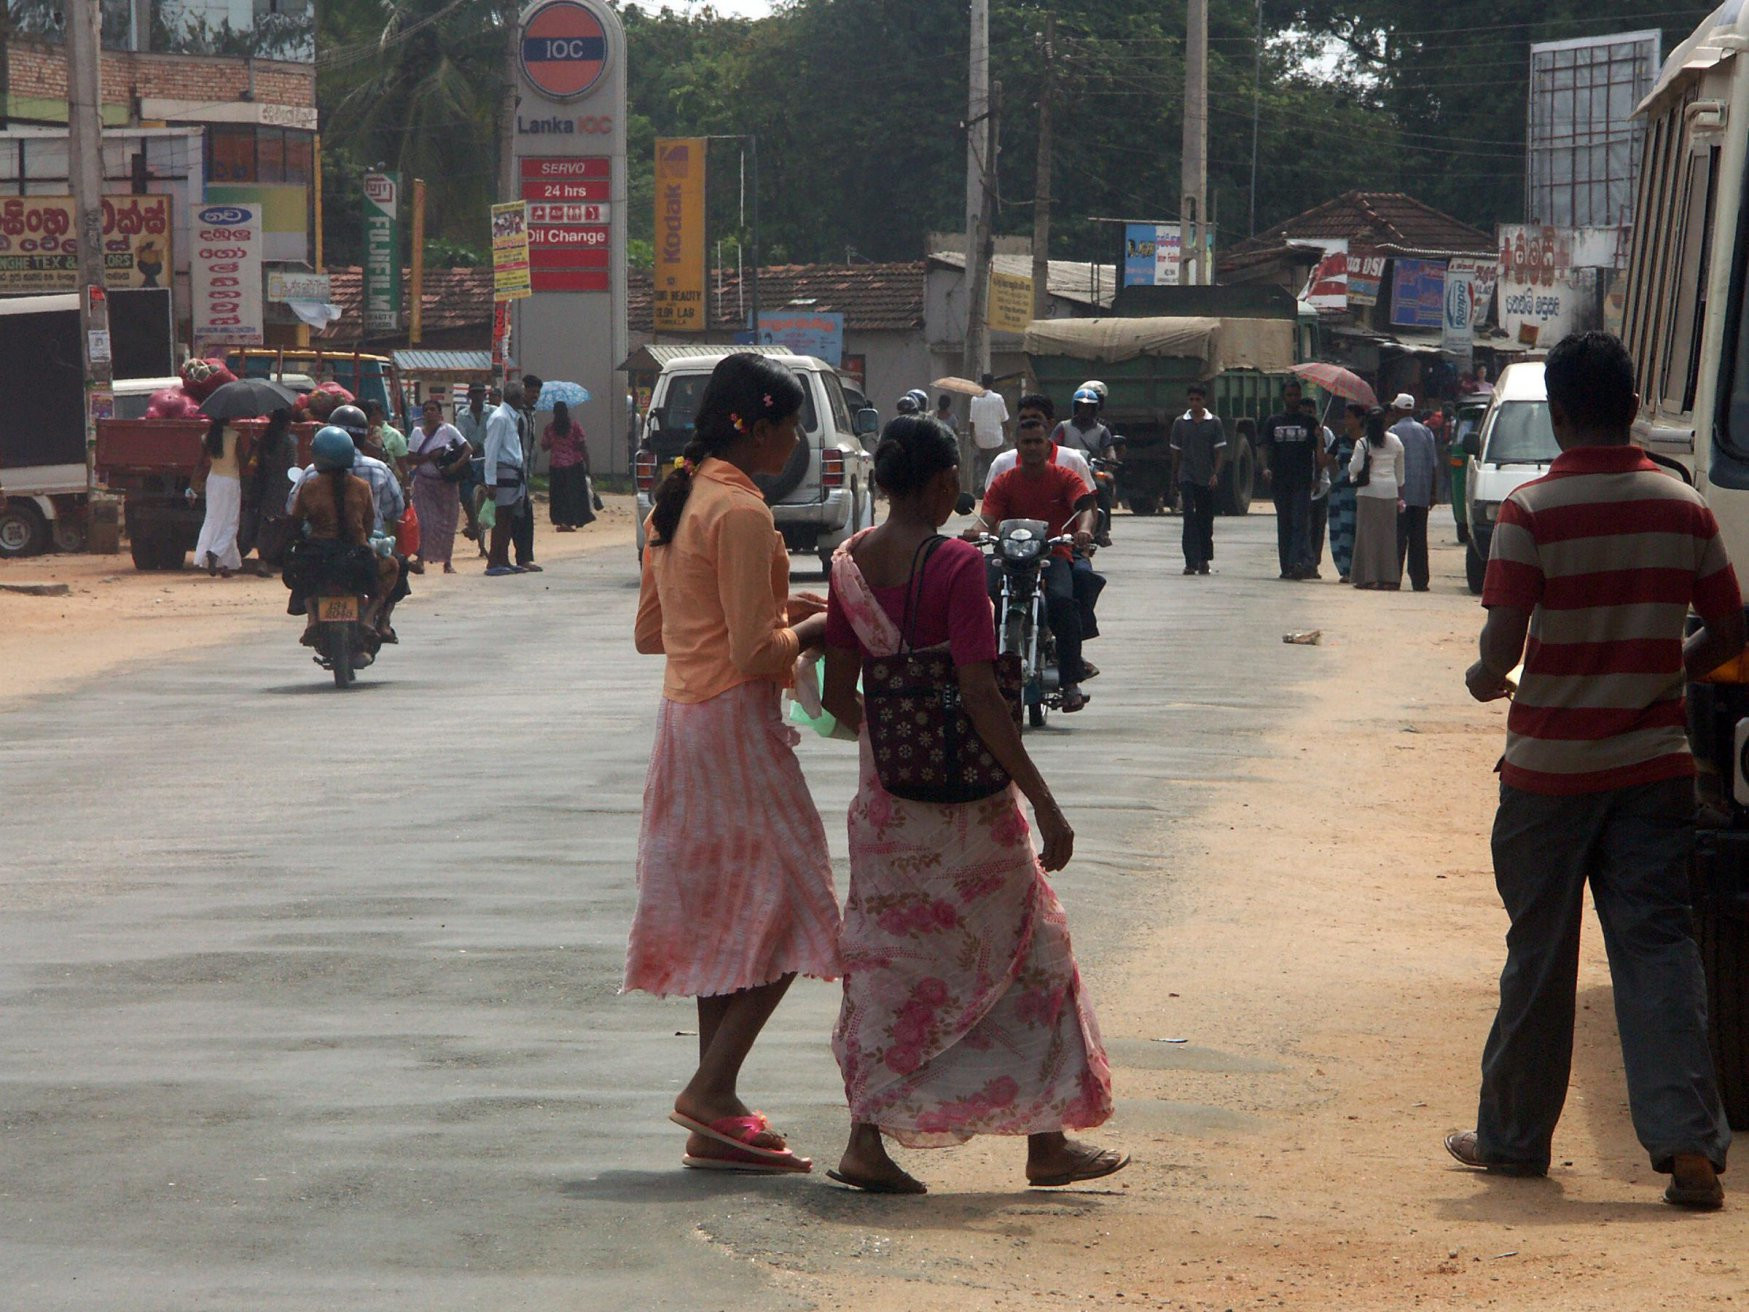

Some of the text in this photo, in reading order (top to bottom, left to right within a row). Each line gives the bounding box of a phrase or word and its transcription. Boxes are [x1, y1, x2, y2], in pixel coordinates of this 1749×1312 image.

[546, 40, 583, 58] IOC
[518, 115, 613, 134] Lanka IOC
[541, 162, 585, 174] SERVO
[545, 184, 586, 197] 24 hrs
[663, 183, 682, 264] Kodak
[548, 229, 606, 245] Change
[33, 256, 62, 270] TEX
[368, 216, 391, 311] FUJIFILM
[1362, 256, 1386, 277] DSI
[677, 307, 695, 318] LAB
